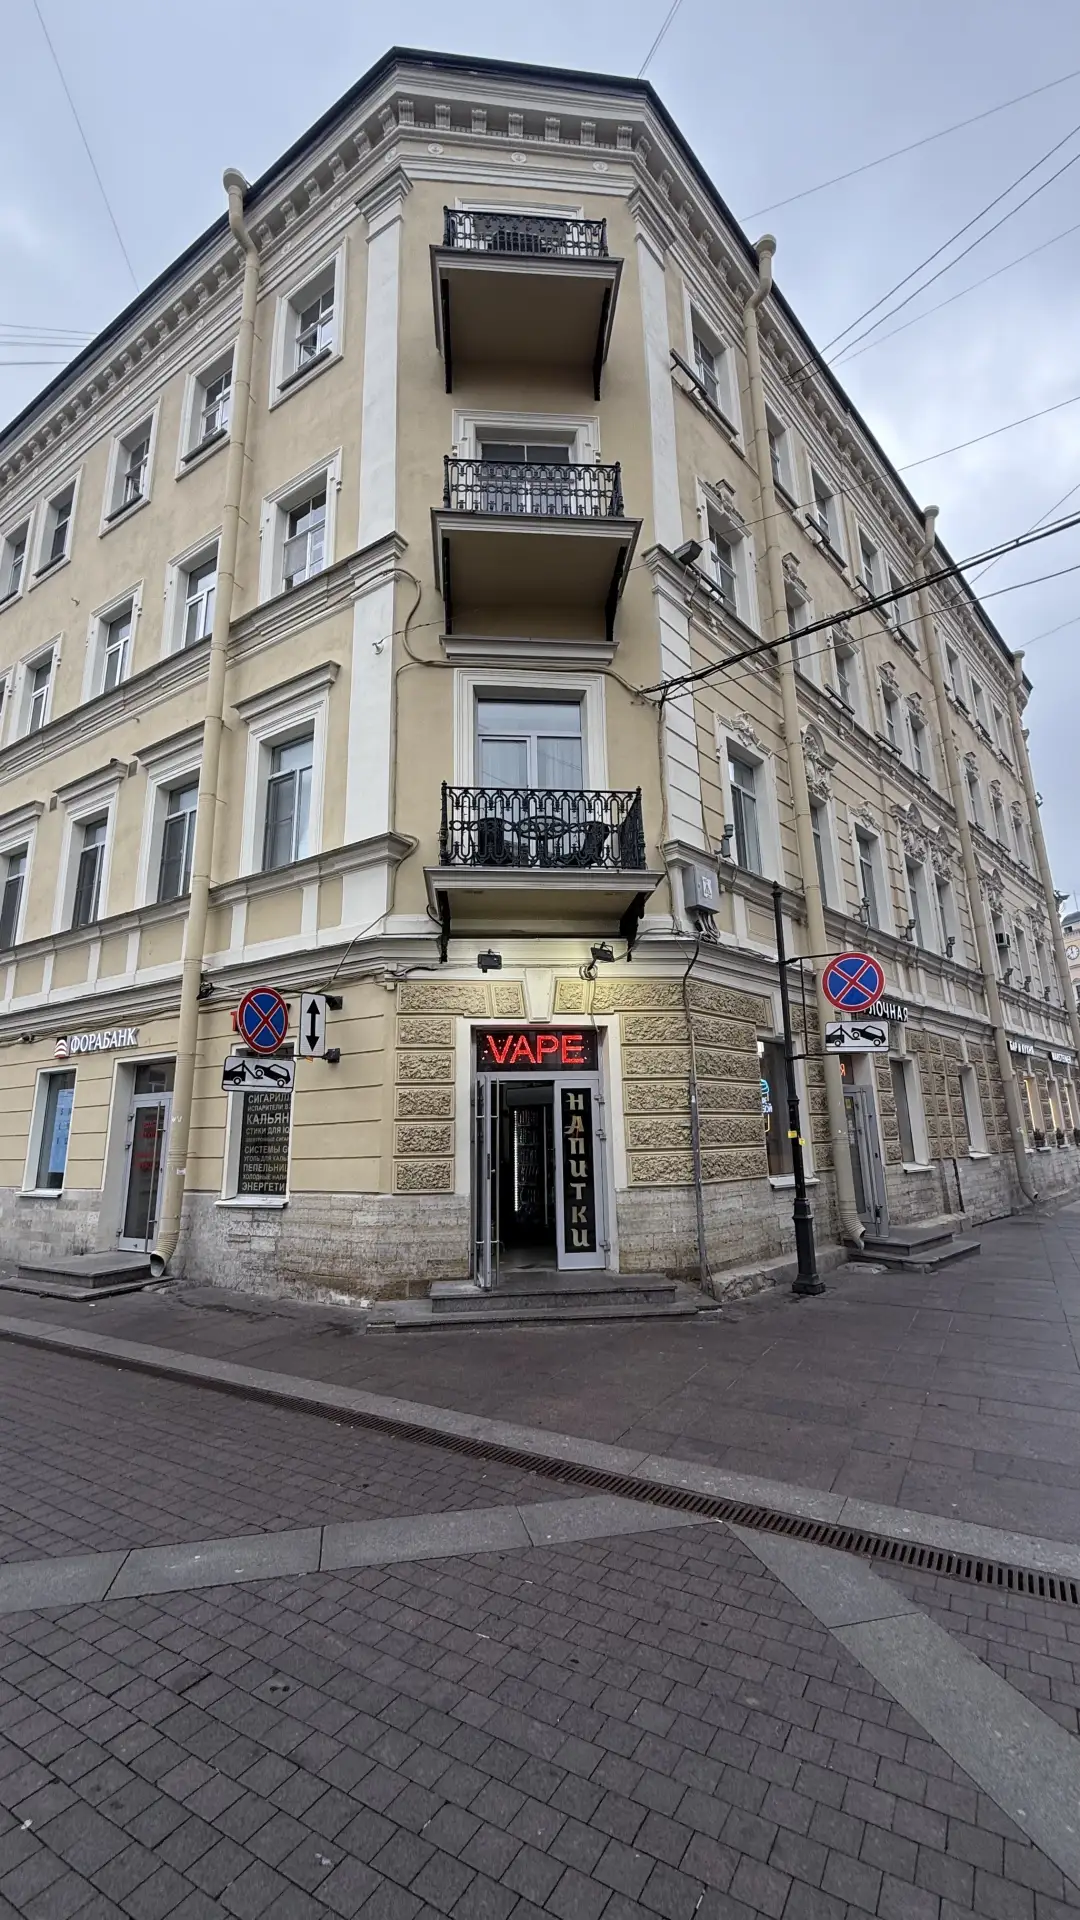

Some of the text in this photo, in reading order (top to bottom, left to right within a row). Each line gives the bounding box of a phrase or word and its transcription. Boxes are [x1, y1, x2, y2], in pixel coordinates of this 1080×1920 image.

[866, 1000, 908, 1022] ЛОЧНАЯ
[70, 1027, 138, 1053] ФОРАБАНК
[487, 1035, 585, 1063] VAPE
[267, 1126, 281, 1135] ДЛЯ
[244, 1145, 281, 1154] СИСТЕМЫ
[564, 1092, 590, 1247] НАПИТКИ
[242, 1181, 285, 1192] ЭНЕРГЕТИ
